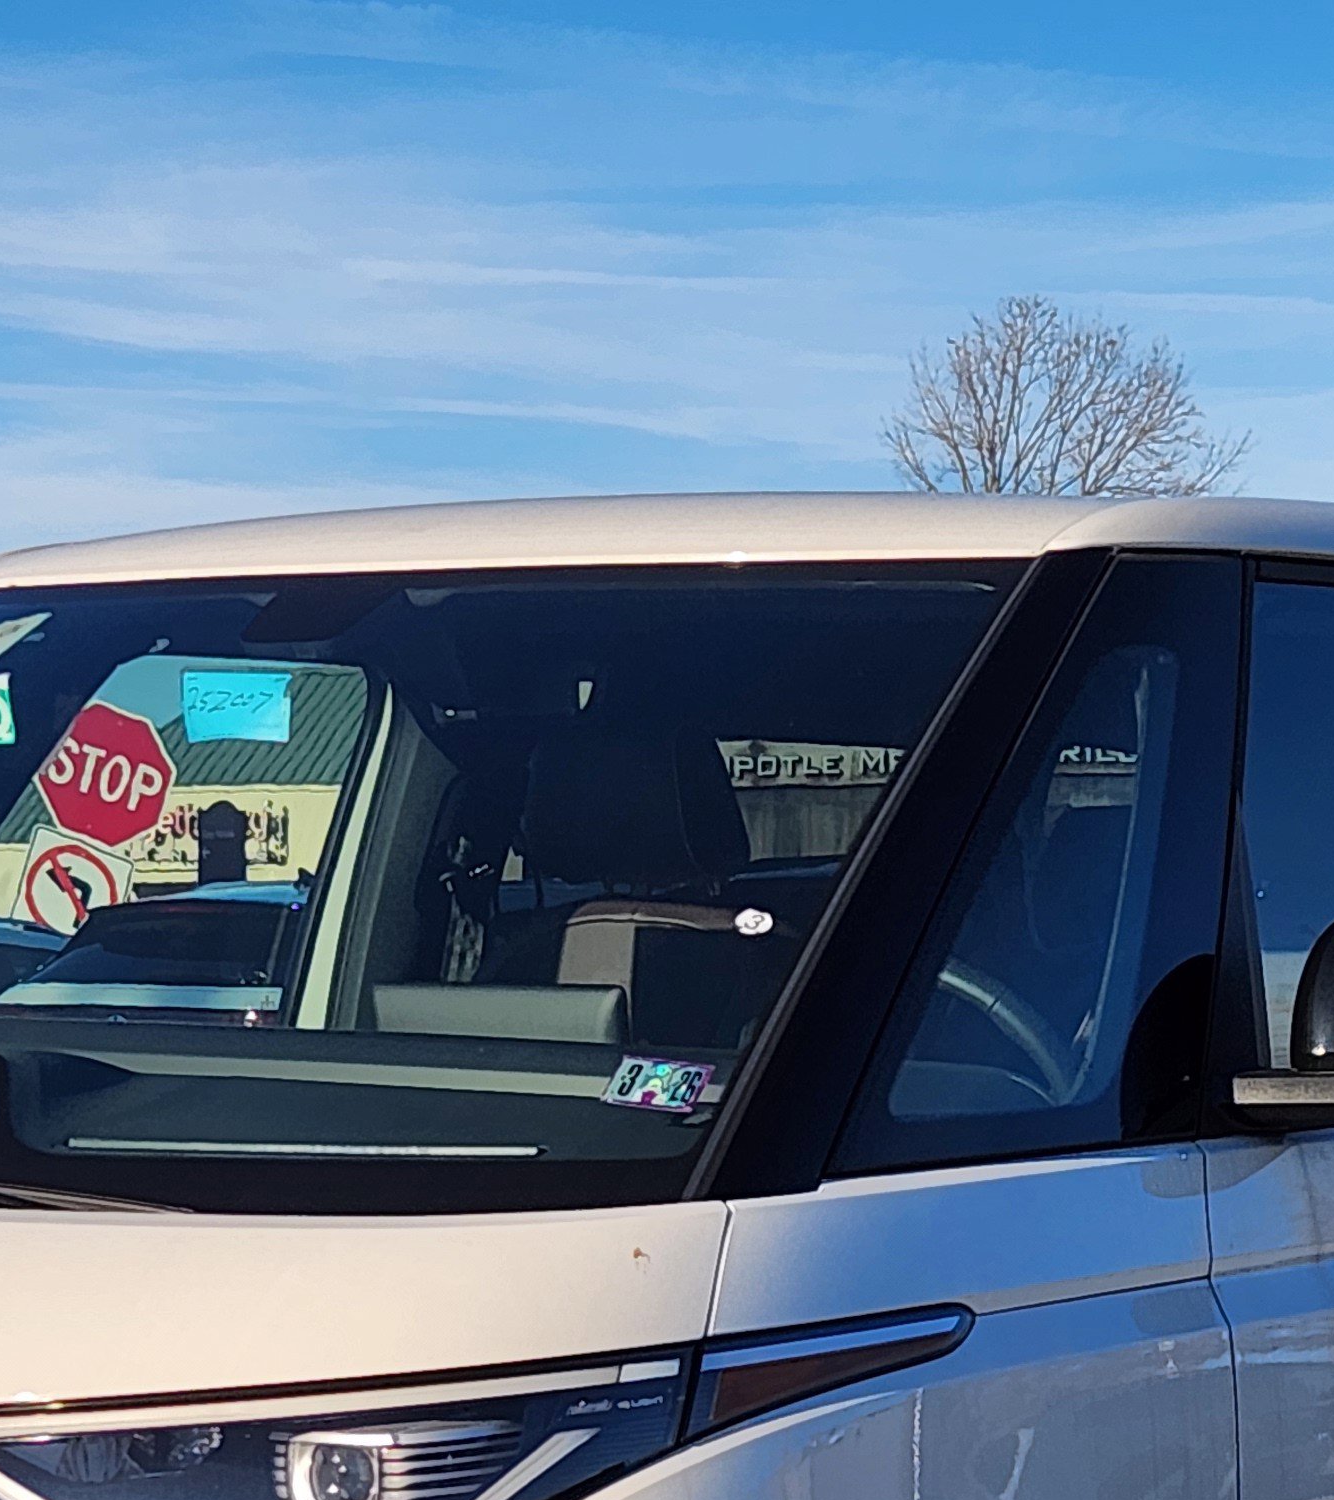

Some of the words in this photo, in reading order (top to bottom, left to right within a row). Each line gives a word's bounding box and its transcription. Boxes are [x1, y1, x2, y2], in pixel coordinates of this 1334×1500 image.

[47, 736, 163, 812] STOP
[725, 752, 844, 778] POTLE
[616, 1063, 645, 1097] 3
